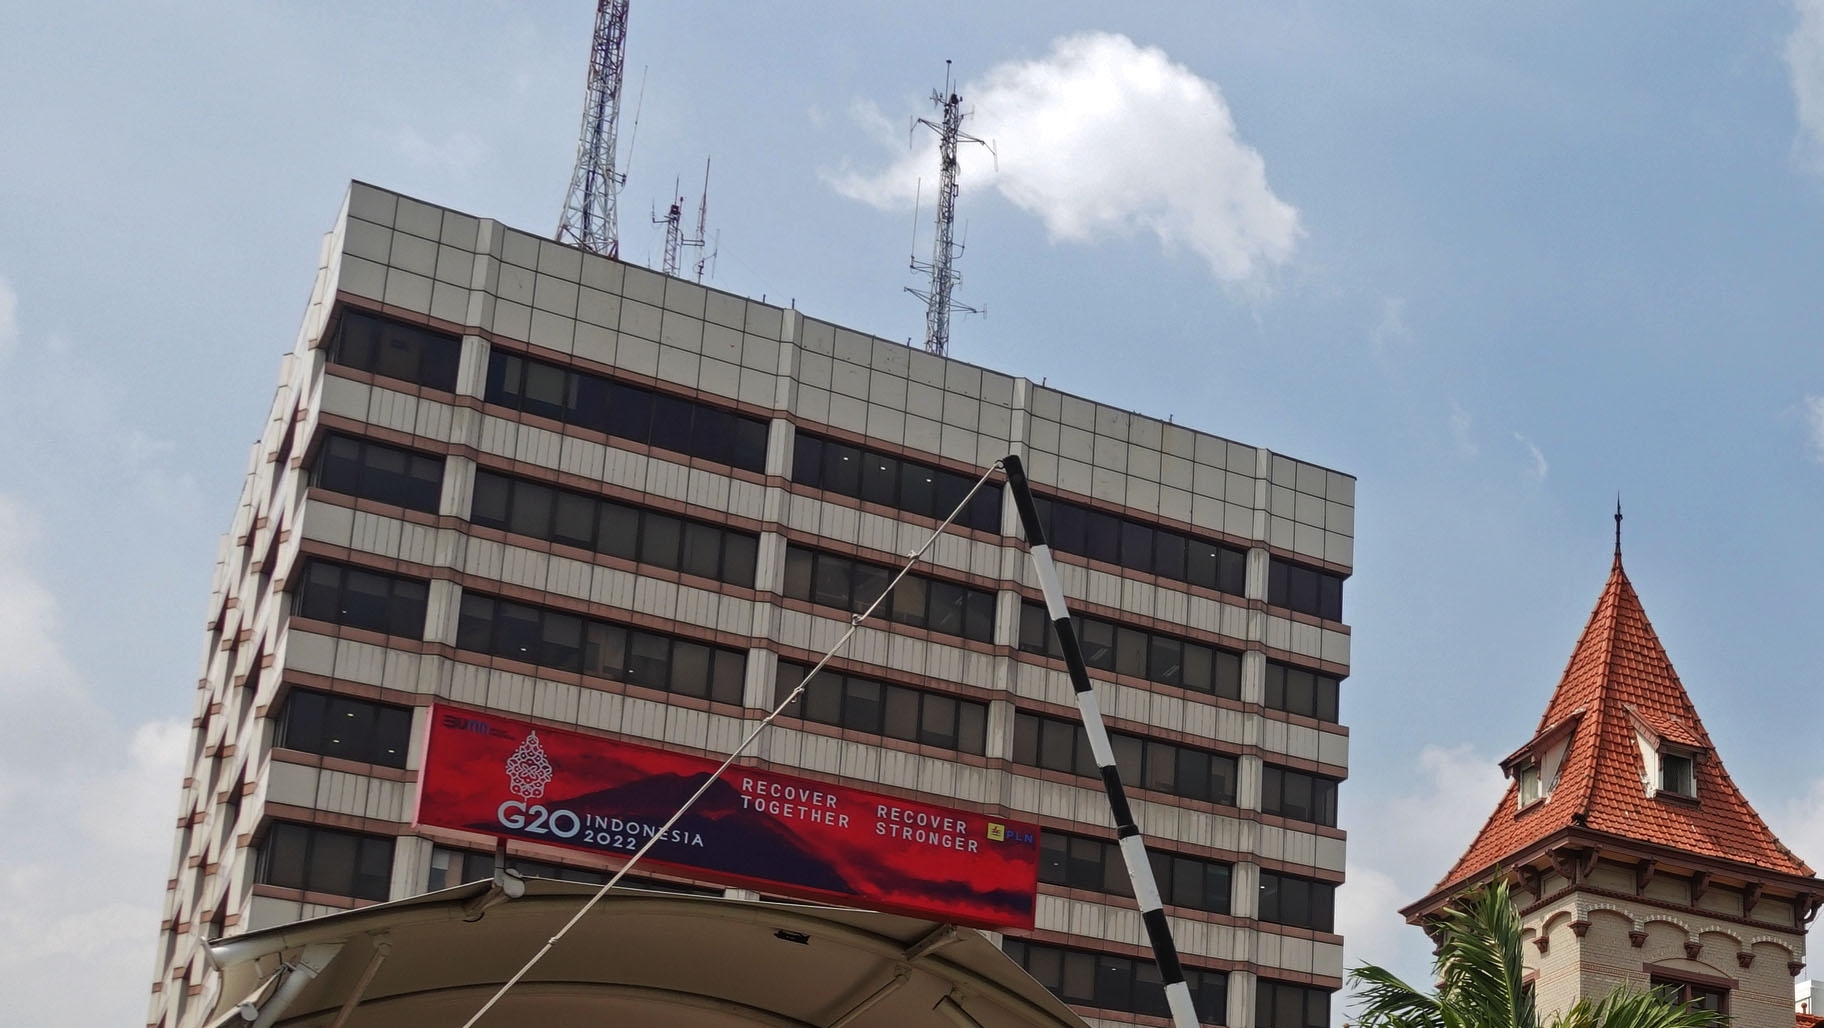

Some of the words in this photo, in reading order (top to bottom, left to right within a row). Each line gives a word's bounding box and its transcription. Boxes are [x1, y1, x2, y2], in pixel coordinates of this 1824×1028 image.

[741, 777, 838, 809] RECOVER
[497, 800, 582, 838] G20
[740, 795, 850, 828] TOGETHER
[876, 805, 968, 834] RECOVER
[583, 830, 637, 850] 2022
[585, 813, 705, 848] INDONESIA
[875, 822, 979, 853] STRONGER
[1005, 830, 1034, 844] PLN
